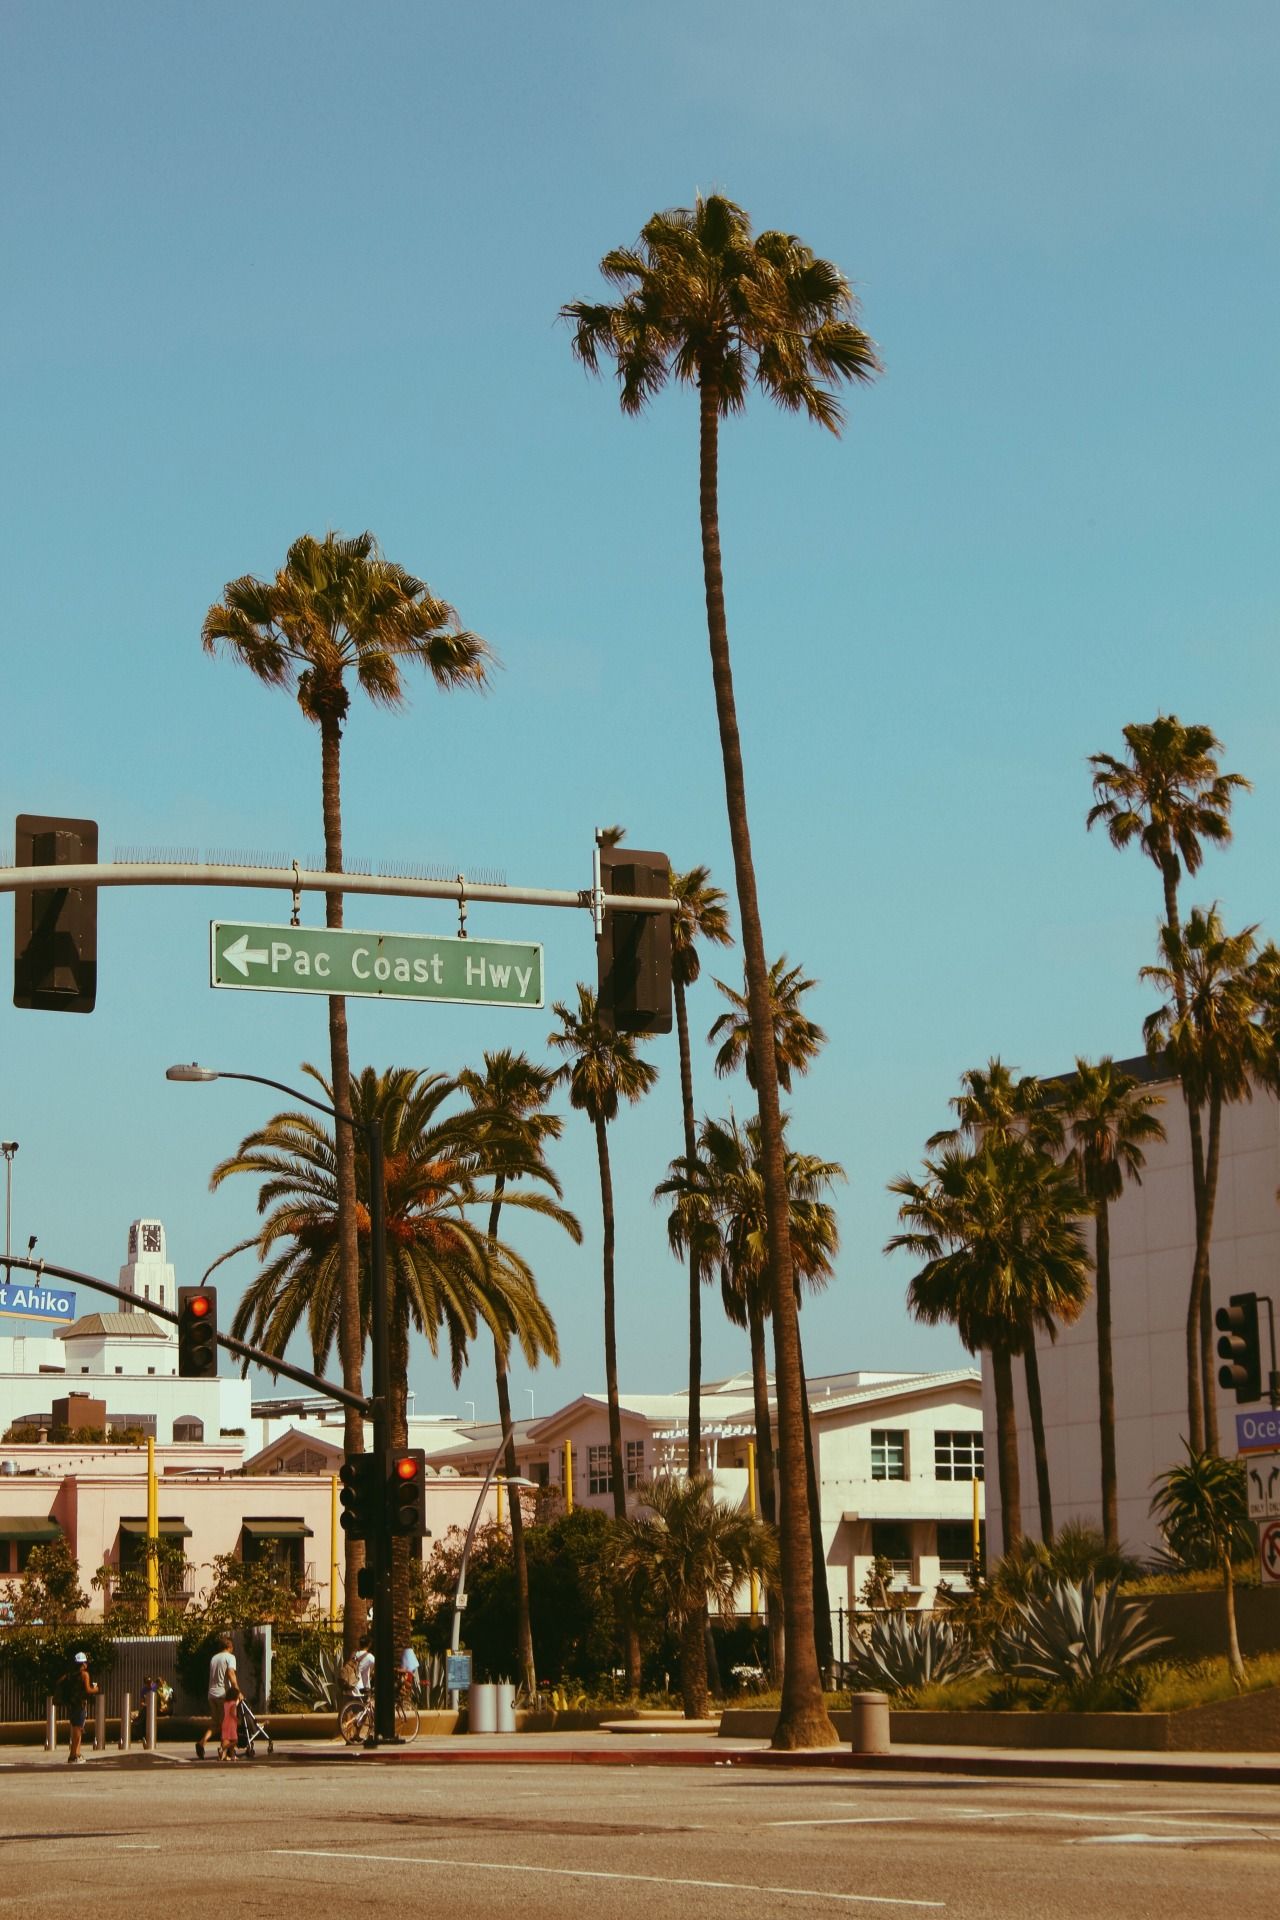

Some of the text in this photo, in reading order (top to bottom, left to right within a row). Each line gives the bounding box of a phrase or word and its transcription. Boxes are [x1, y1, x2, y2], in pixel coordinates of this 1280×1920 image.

[271, 942, 533, 998] Pac Coast Hwy
[12, 1289, 70, 1313] Ahiko
[1243, 1418, 1280, 1440] Oce
